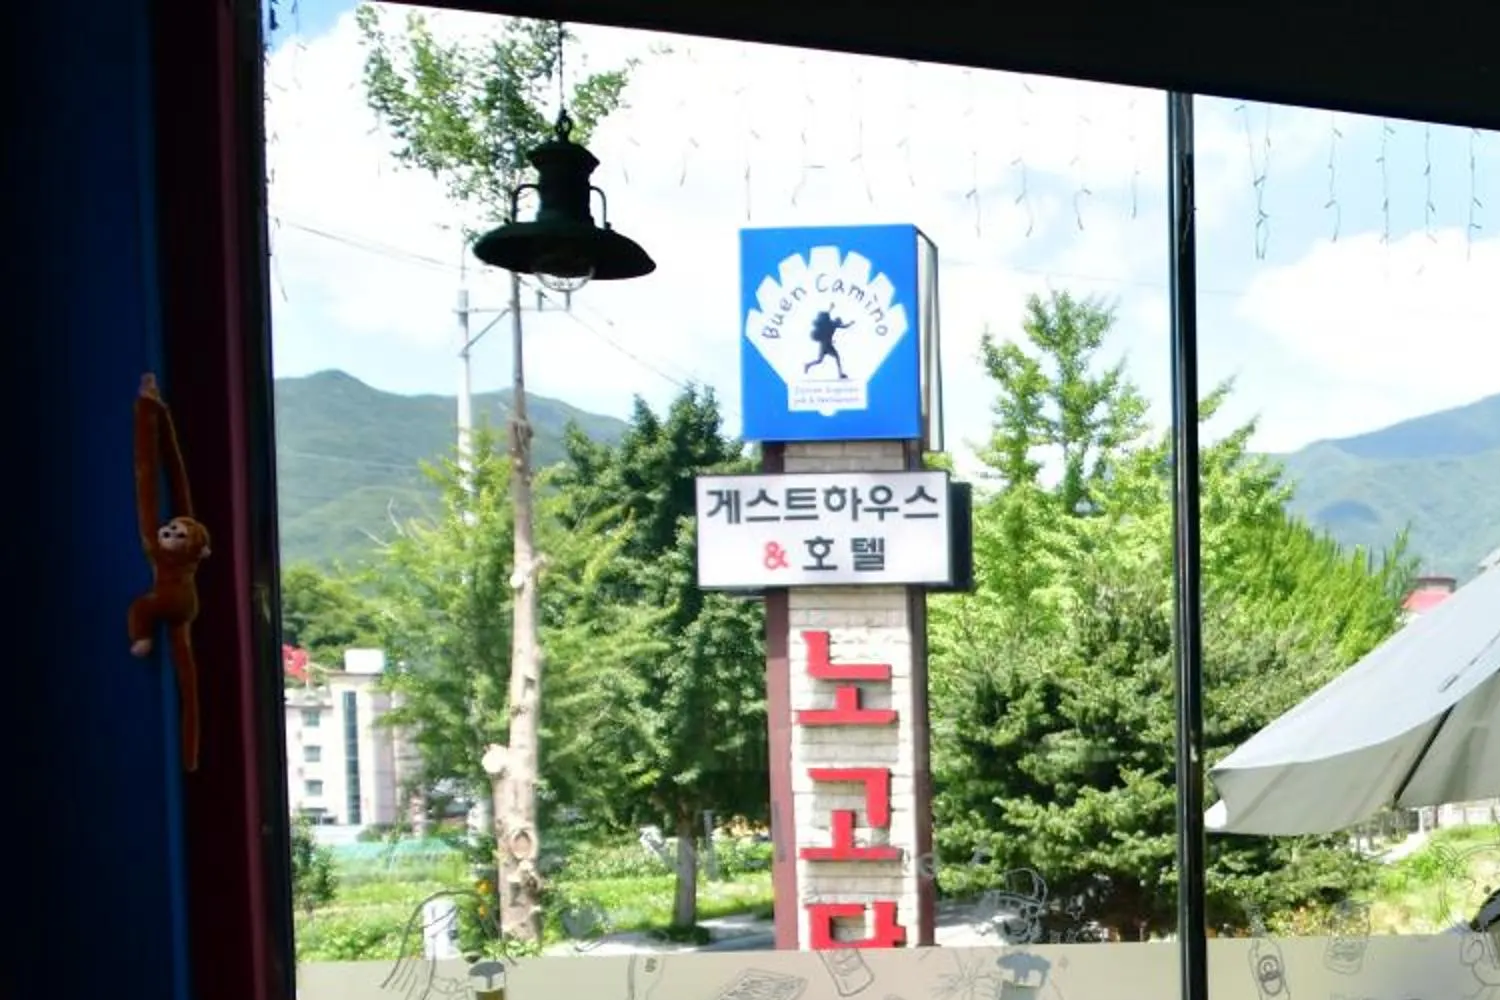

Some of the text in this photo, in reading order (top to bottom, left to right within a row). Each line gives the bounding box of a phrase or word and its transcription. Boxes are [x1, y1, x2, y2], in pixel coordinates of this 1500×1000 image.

[761, 272, 889, 339] Buen Camino
[705, 484, 940, 525] 게스트하우스
[763, 541, 789, 570] &
